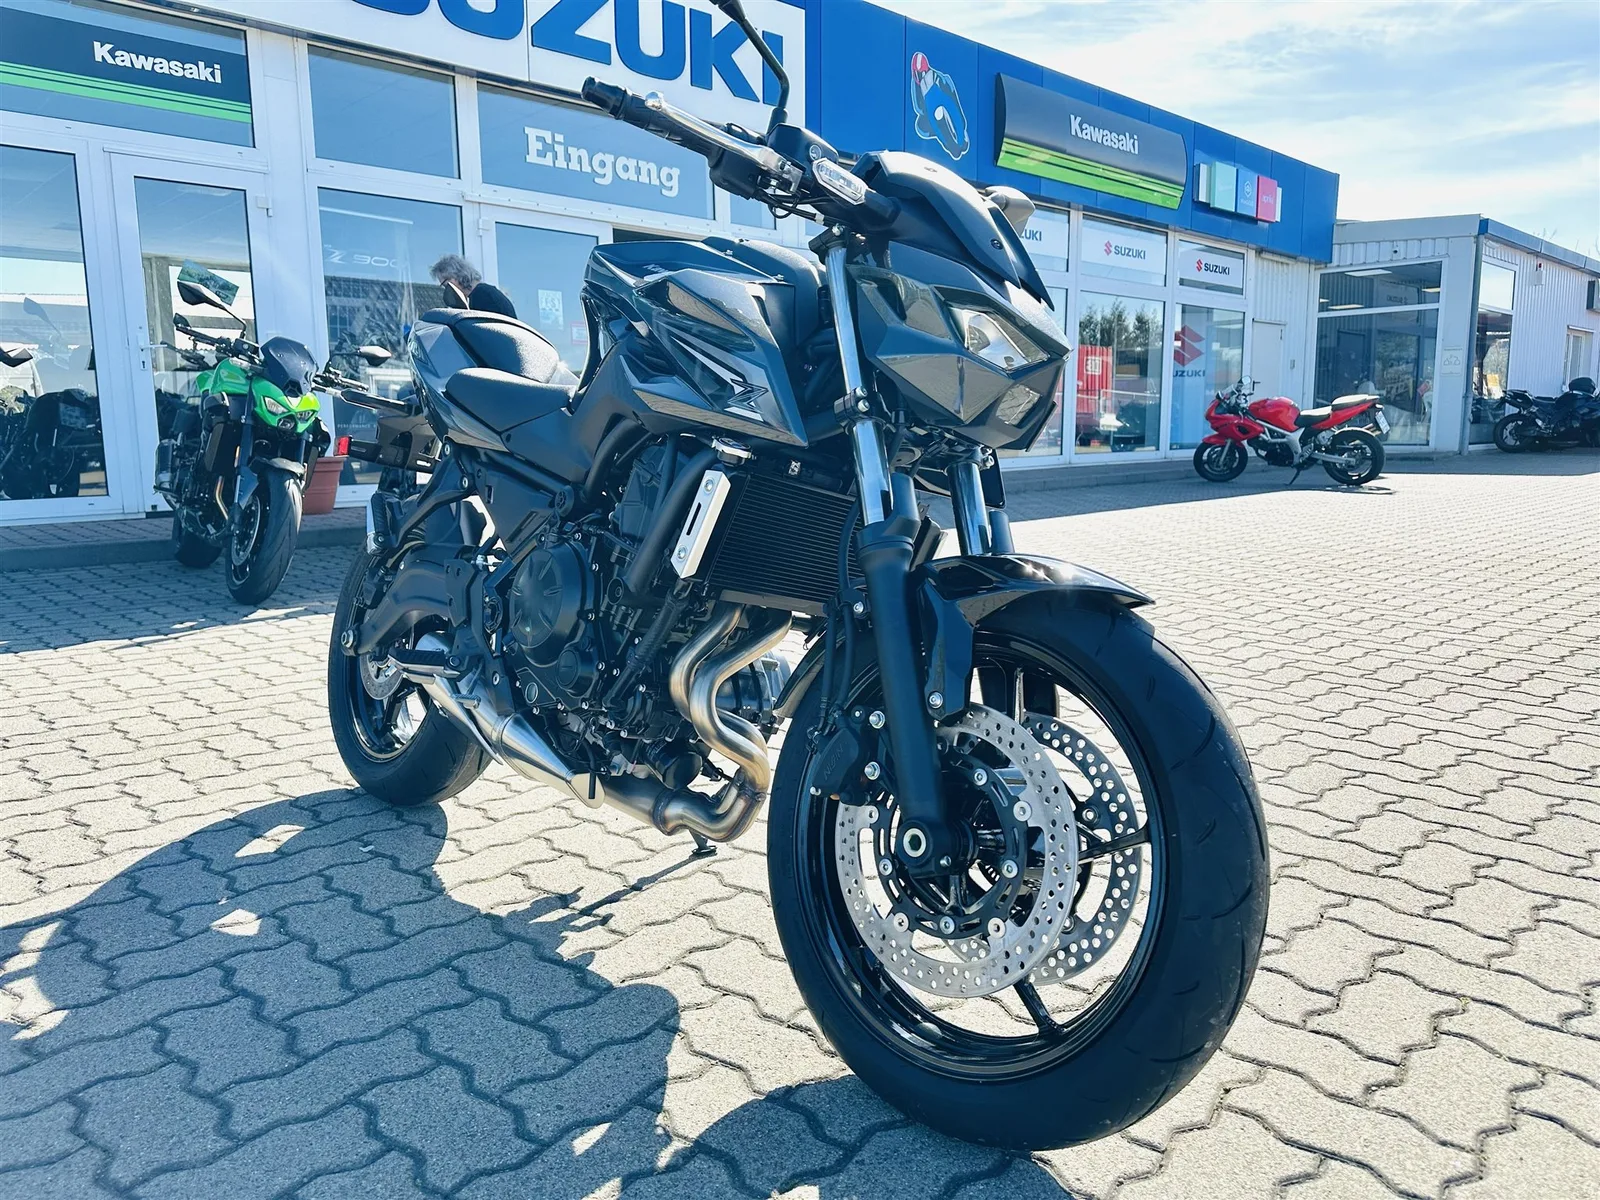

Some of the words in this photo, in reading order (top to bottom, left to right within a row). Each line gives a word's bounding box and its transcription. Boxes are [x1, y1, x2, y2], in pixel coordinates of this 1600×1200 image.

[93, 41, 222, 84] Kawasaki
[353, 0, 784, 106] ZUKI
[1069, 114, 1139, 155] Kawasaki
[524, 126, 681, 198] Eingang
[1020, 229, 1043, 242] UKI
[1113, 244, 1147, 260] SUZUKI
[1203, 262, 1231, 276] SUZUKI
[1172, 369, 1206, 378] UZUKI
